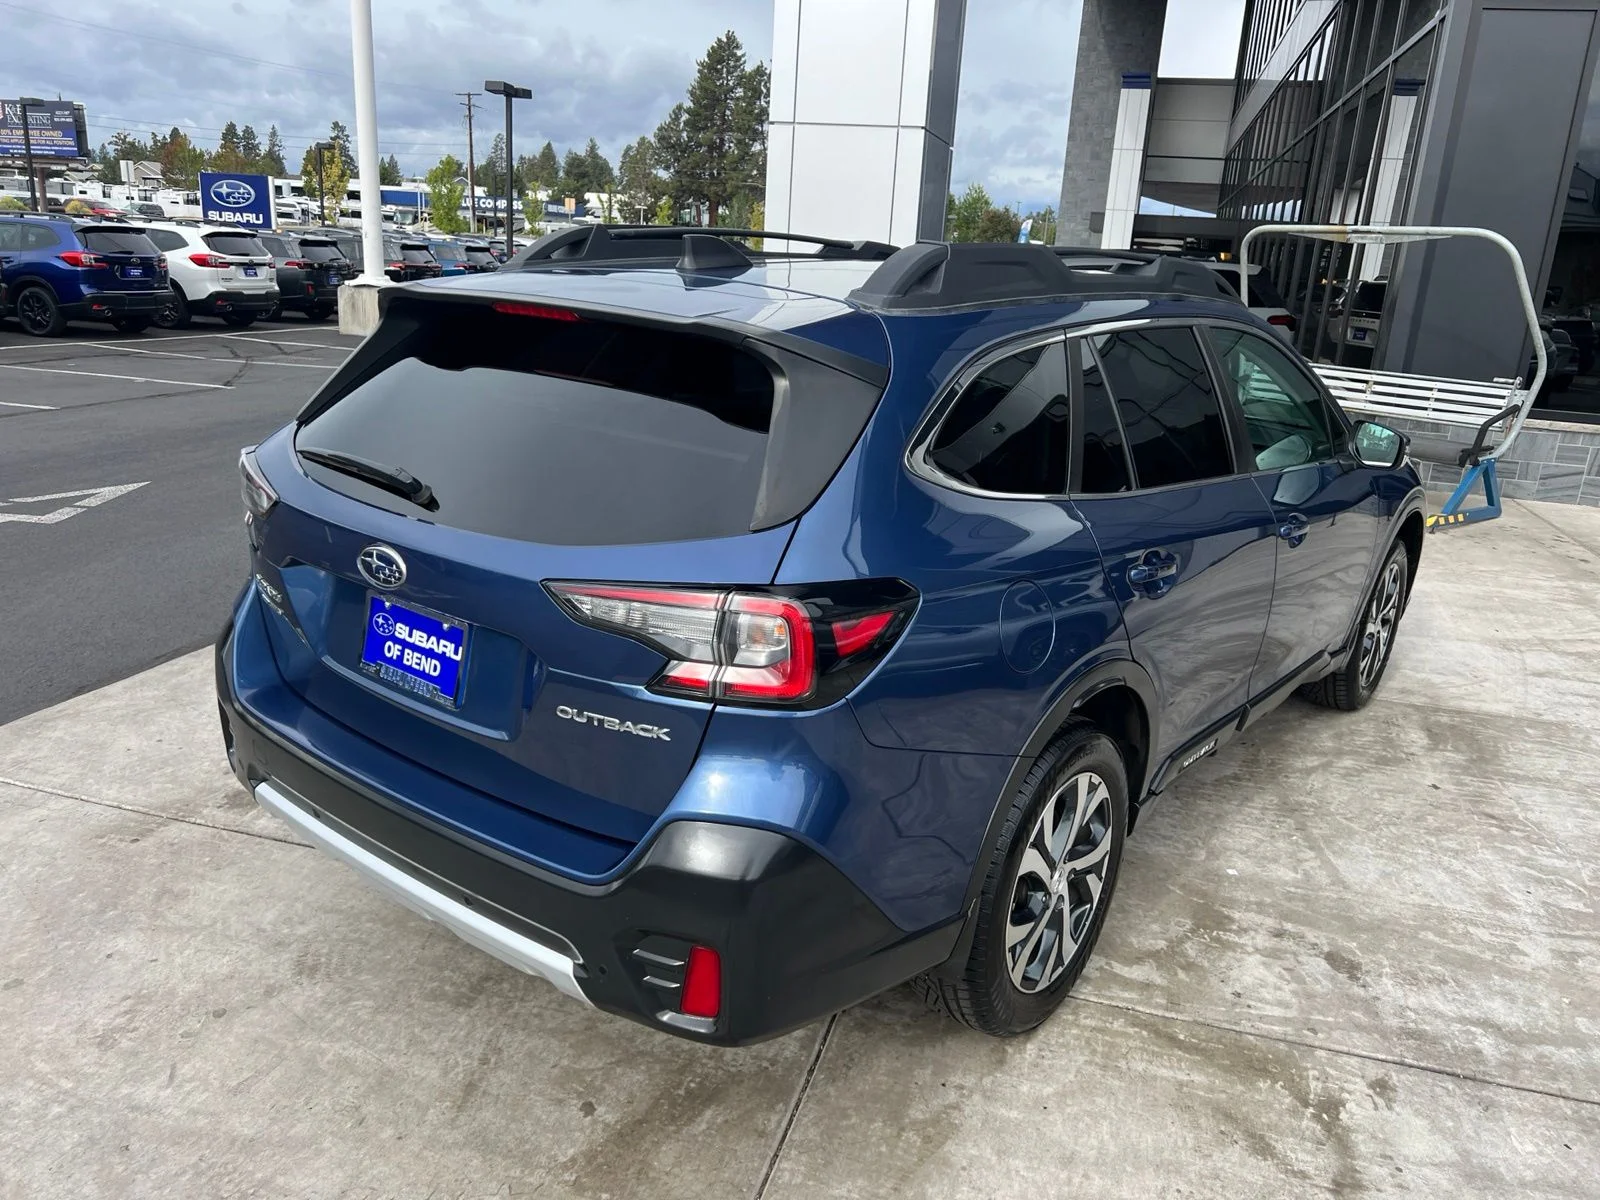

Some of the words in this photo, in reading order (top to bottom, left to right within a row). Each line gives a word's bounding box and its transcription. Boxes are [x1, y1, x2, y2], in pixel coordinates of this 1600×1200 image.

[7, 115, 51, 124] EXCATING
[13, 129, 40, 137] EMPYEE
[461, 198, 478, 208] LUE
[480, 199, 523, 210] COMPSS
[207, 210, 264, 225] SUBARU
[395, 622, 463, 661] SUBARU
[384, 641, 402, 660] OF
[403, 648, 441, 677] BEND
[556, 705, 671, 741] OUTBACK
